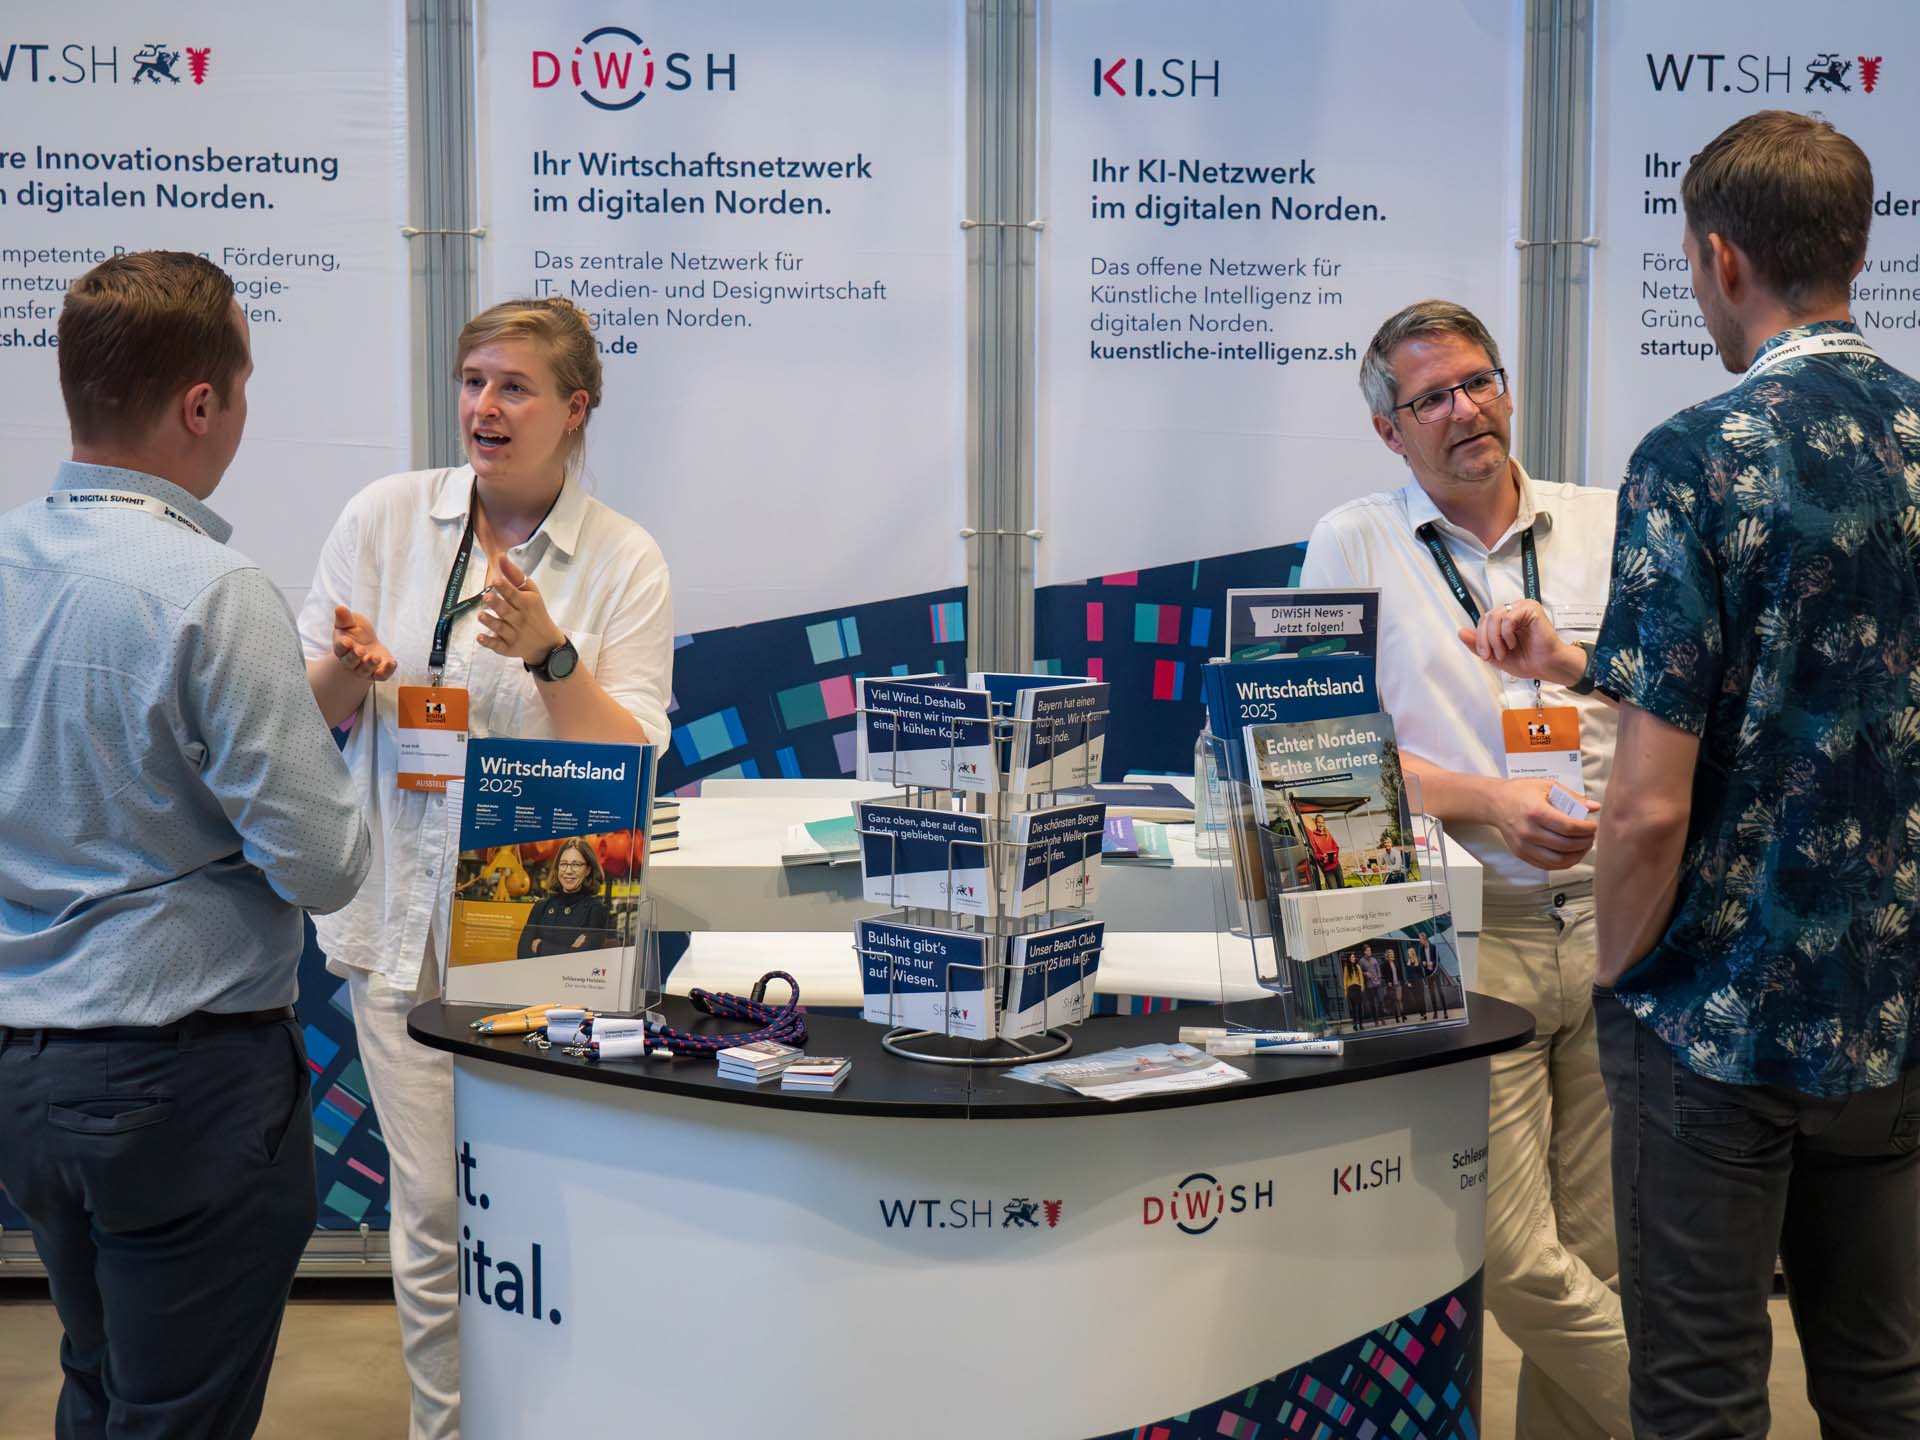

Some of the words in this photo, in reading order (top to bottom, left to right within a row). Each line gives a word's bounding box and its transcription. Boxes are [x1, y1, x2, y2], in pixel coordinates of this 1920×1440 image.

[532, 46, 736, 91] DiWiSH
[1094, 58, 1220, 97] KI.SH
[1646, 54, 1791, 93] WT.SH
[37, 145, 339, 181] Innovationsberatung
[533, 151, 571, 176] Ihr
[579, 151, 872, 179] Wirtschaftsnetzwerk
[1092, 158, 1130, 183] Ihr
[1138, 159, 1316, 185] KI-Netzwerk
[1645, 153, 1681, 178] Ihr
[17, 180, 146, 213] digitalen
[157, 184, 274, 209] Norden.
[533, 188, 568, 213] im
[578, 188, 705, 219] digitalen
[715, 190, 832, 215] Norden.
[1644, 191, 1677, 214] im
[1091, 196, 1125, 220] im
[1136, 195, 1261, 226] digitalen
[1271, 197, 1387, 221] Norden.
[224, 248, 341, 272] Förderung,
[534, 251, 573, 270] Das
[580, 251, 663, 271] zentrale
[671, 252, 768, 271] Netzwerk
[775, 252, 803, 271] für
[1091, 258, 1130, 276] Das
[1136, 257, 1202, 276] offene
[1210, 258, 1307, 277] Netzwerk
[1312, 257, 1341, 277] für
[572, 278, 659, 298] Medien-
[665, 280, 705, 299] und
[713, 279, 887, 304] Designwirtschaft
[1091, 285, 1197, 304] Künstliche
[1204, 285, 1311, 310] Intelligenz
[1318, 286, 1343, 305] im
[583, 307, 659, 331] gitalen
[667, 308, 752, 327] Norden.
[1090, 313, 1181, 337] digitalen
[1189, 314, 1273, 333] Norden.
[1091, 340, 1356, 365] kuenstliche-intelligenz.sh
[1766, 344, 1801, 362] SUMMIT
[79, 494, 108, 502] DIGITAL
[110, 495, 145, 506] SUMMIT
[1271, 608, 1311, 619] DiWiSH
[1314, 608, 1344, 618] News
[1273, 623, 1302, 634] Jetzt
[1306, 621, 1344, 635] folgen!
[871, 688, 890, 701] Viel
[892, 690, 922, 705] Wind.
[924, 695, 966, 710] Deshalb
[1236, 674, 1364, 700] Wirtschaftsland
[924, 711, 939, 722] wir
[1038, 699, 1062, 713] Bayern
[1064, 697, 1076, 708] hat
[1076, 696, 1096, 707] einen
[1240, 703, 1277, 721] 2025
[903, 721, 936, 737] kühlen
[1068, 712, 1080, 725] Wir
[1035, 730, 1070, 745] Tausnde.
[1266, 736, 1314, 756] Echter
[1317, 728, 1381, 749] Norden.
[481, 756, 626, 781] Wirtschaftsland
[1270, 759, 1313, 777] Echte
[1315, 751, 1383, 772] Karriere.
[479, 777, 523, 797] 2025
[868, 813, 891, 824] Ganz
[893, 815, 918, 827] oben,
[921, 817, 940, 829] aber
[942, 821, 956, 831] auf
[958, 822, 977, 834] dem
[1032, 822, 1043, 834] Die
[1043, 818, 1076, 832] schönsten
[1077, 814, 1099, 826] Berge
[901, 829, 947, 843] geblieben.
[1062, 831, 1086, 843] Welle
[1028, 854, 1042, 867] zum
[1043, 849, 1066, 863] Srfen.
[868, 931, 911, 949] Bullshit
[1029, 944, 1051, 958] Unser
[1053, 936, 1077, 952] Beach
[1078, 931, 1096, 946] Club
[914, 958, 934, 970] nur
[1059, 956, 1070, 968] km
[869, 966, 888, 979] auf
[893, 967, 938, 988] Wiesen.
[456, 1141, 490, 1210] t.
[1333, 1155, 1401, 1196] KI.SH
[1460, 1173, 1477, 1190] Der
[879, 1199, 992, 1228] WT.SH
[1143, 1179, 1273, 1226] DiWiSH
[457, 1225, 562, 1325] ital.
